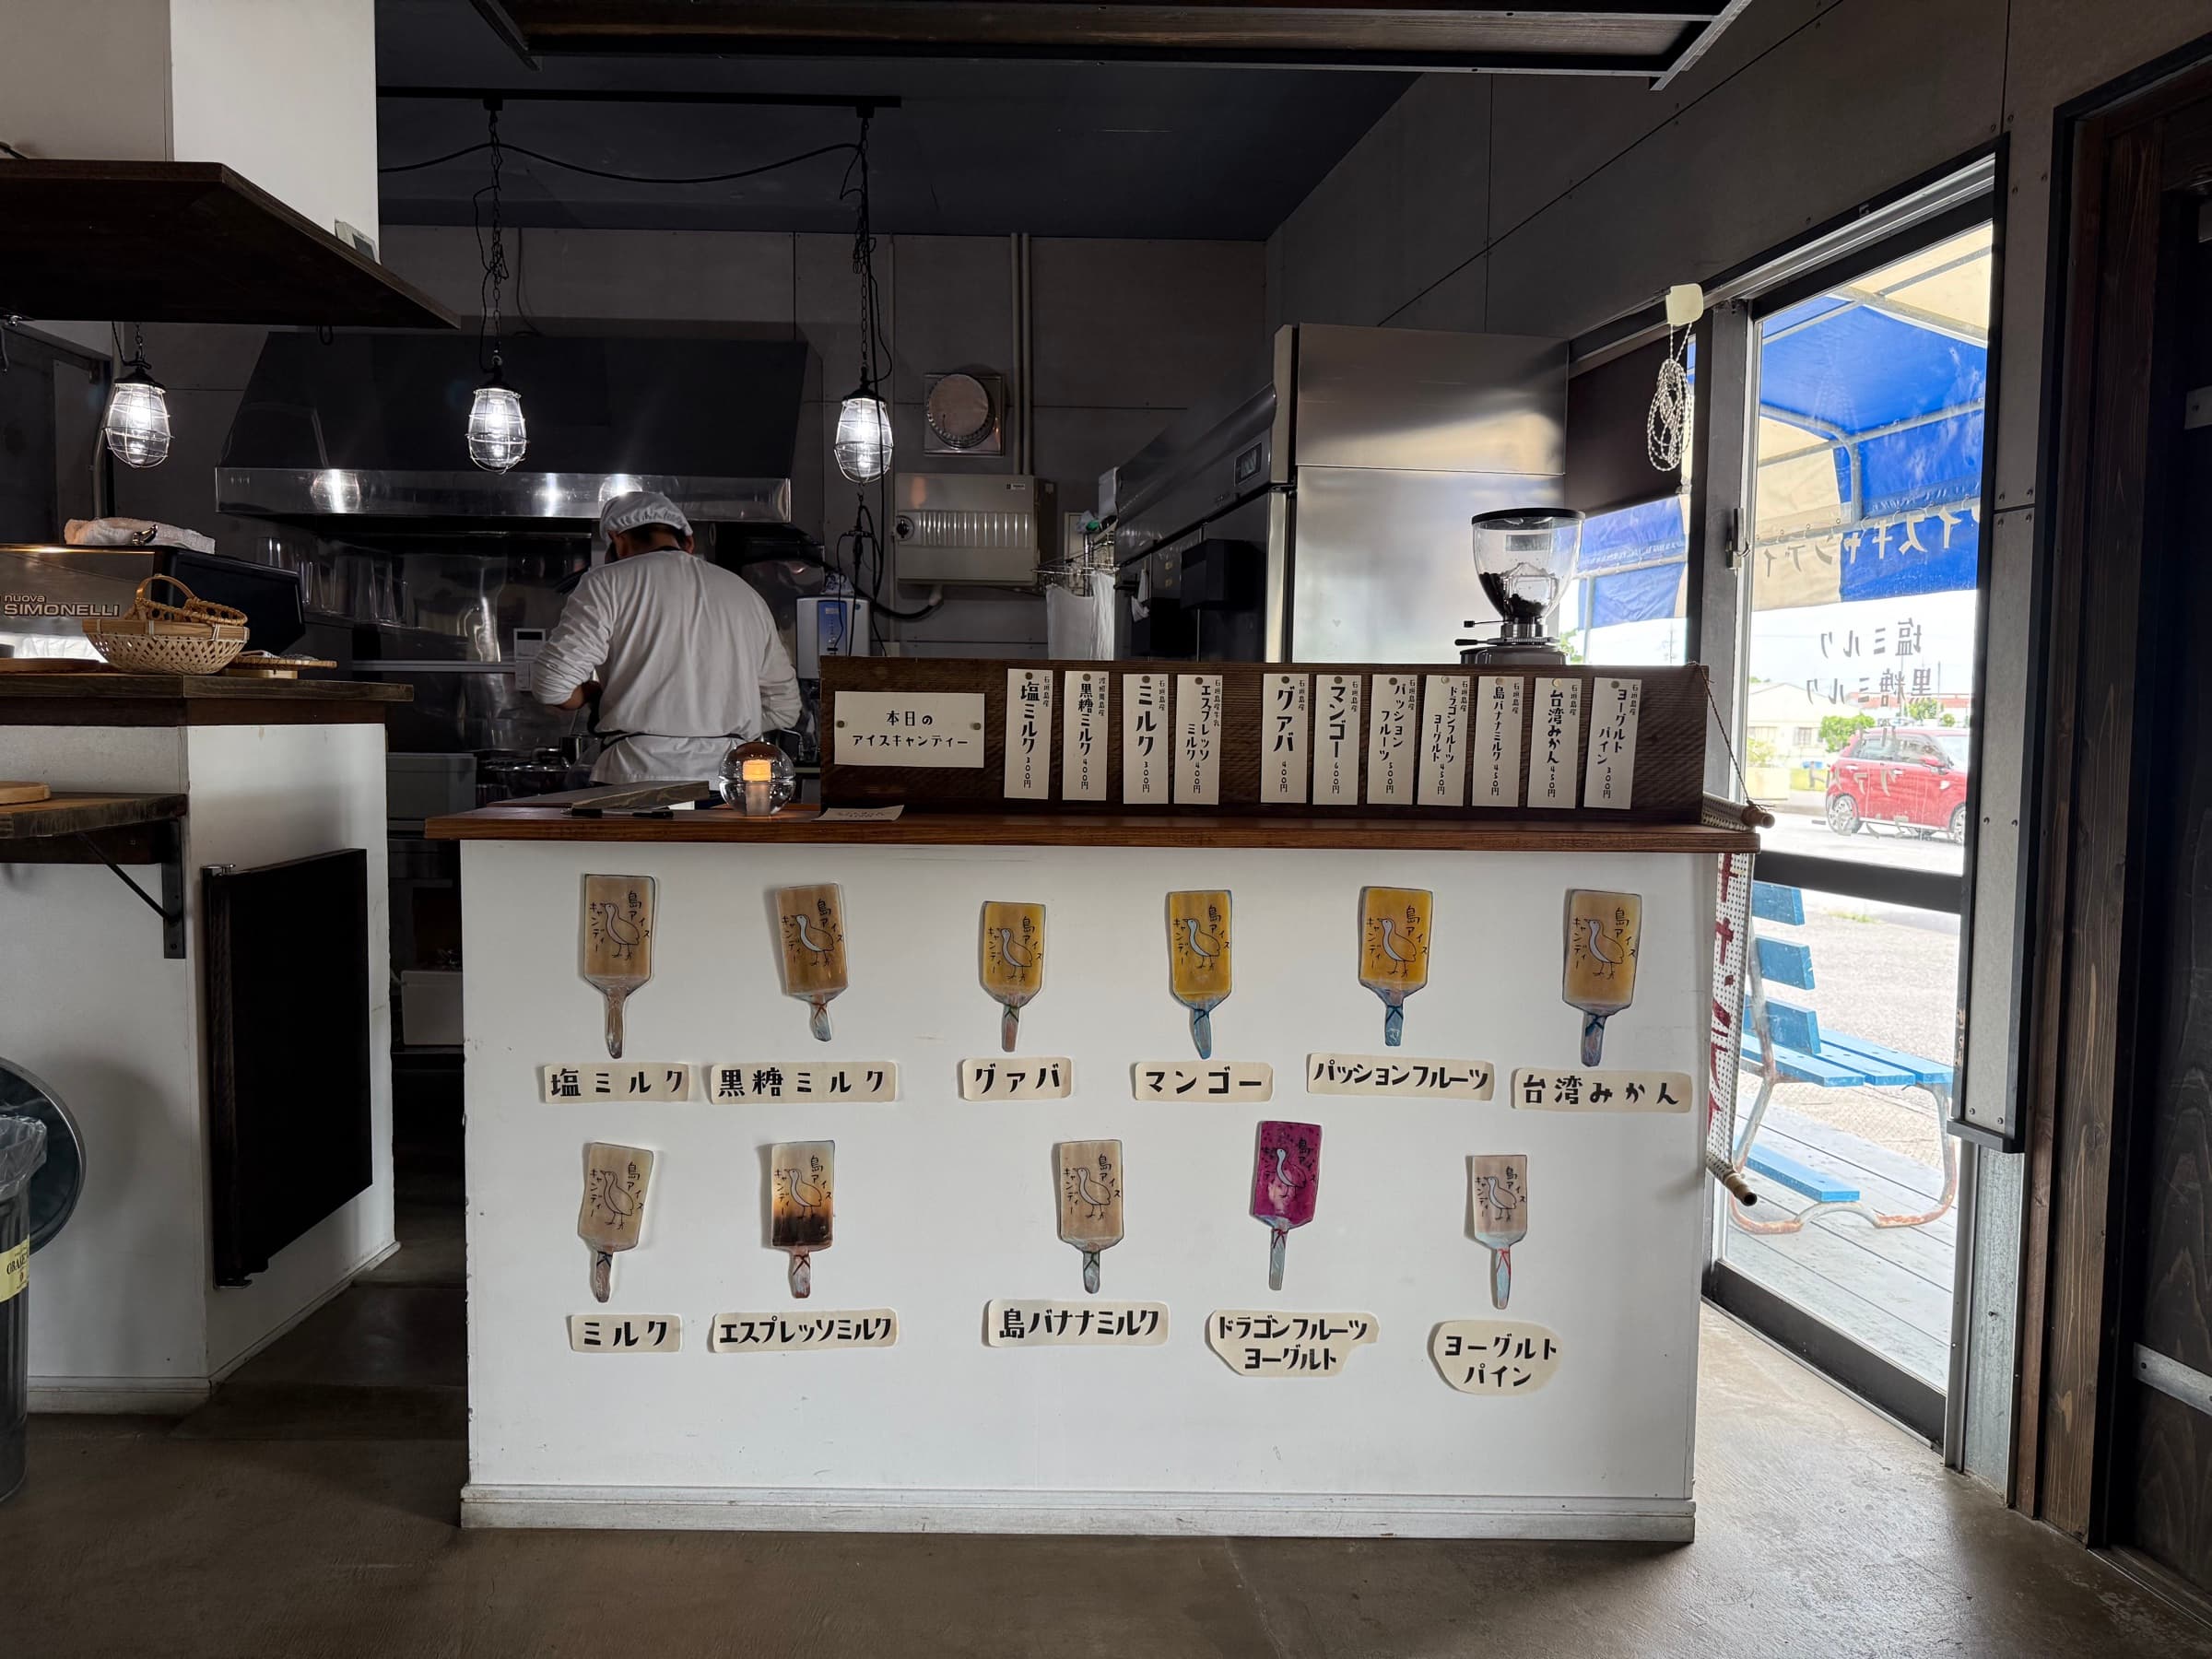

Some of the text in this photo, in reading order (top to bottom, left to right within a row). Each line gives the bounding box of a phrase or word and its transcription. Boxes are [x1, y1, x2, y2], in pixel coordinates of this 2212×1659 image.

[4, 604, 119, 616] SIMONELLI
[887, 711, 933, 726] 本日の
[1020, 681, 1040, 754] 塩ミルク
[1078, 683, 1094, 756] 黒糖ミルク
[1136, 686, 1158, 757] ミルク
[1200, 685, 1212, 761] エスプレッソ
[1329, 686, 1347, 758] マンゴー
[1393, 683, 1406, 748] パッション
[1445, 686, 1458, 763] ドラゴンフルーツ
[1491, 686, 1505, 761] 島バナナミルク
[1547, 689, 1565, 764] 台湾みかん
[1613, 689, 1628, 753] ヨーグルト
[853, 735, 968, 747] アイスキャンディー
[1186, 724, 1197, 761] ミルク
[1379, 711, 1391, 761] フルーツ
[1431, 714, 1441, 762] ヨーグルト
[1596, 726, 1611, 765] パイン
[551, 1068, 682, 1097] 塩ミルク
[719, 1067, 883, 1097] 黒糖ミルク
[1146, 1065, 1263, 1095] マンゴー
[1314, 1060, 1488, 1090] パッションフルーツ
[1524, 1075, 1679, 1105] 台湾みかん
[583, 1321, 667, 1346] ミルク
[720, 1315, 892, 1345] エスプレッソミルク
[1000, 1308, 1159, 1339] 島バナナミルク
[1219, 1315, 1368, 1341] ドラゴンフルーツ
[1245, 1346, 1336, 1371] ヨーグルト
[1445, 1333, 1557, 1360] ヨーグルト
[1465, 1363, 1531, 1388] パイン
